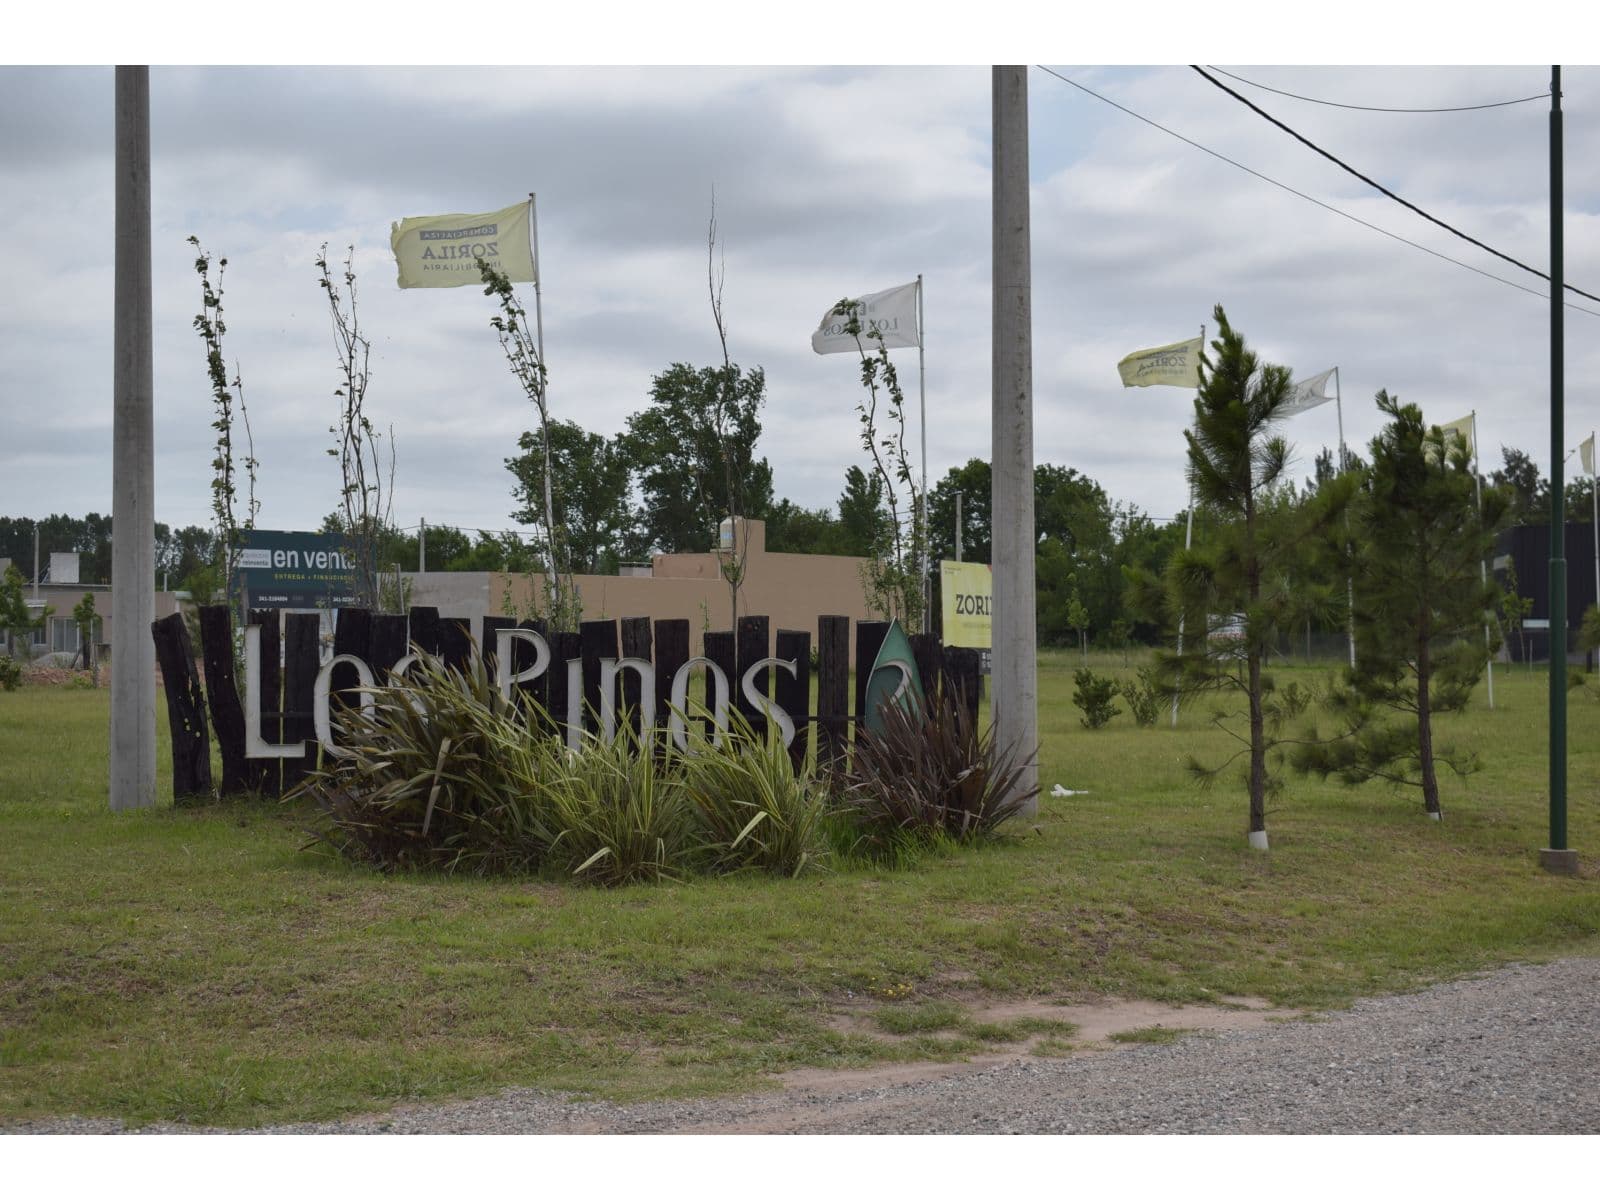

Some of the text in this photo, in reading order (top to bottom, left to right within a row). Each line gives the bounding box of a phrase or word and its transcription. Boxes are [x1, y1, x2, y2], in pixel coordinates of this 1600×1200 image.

[274, 550, 297, 568] en
[956, 594, 992, 615] ZORI
[495, 628, 798, 762] Pinos
